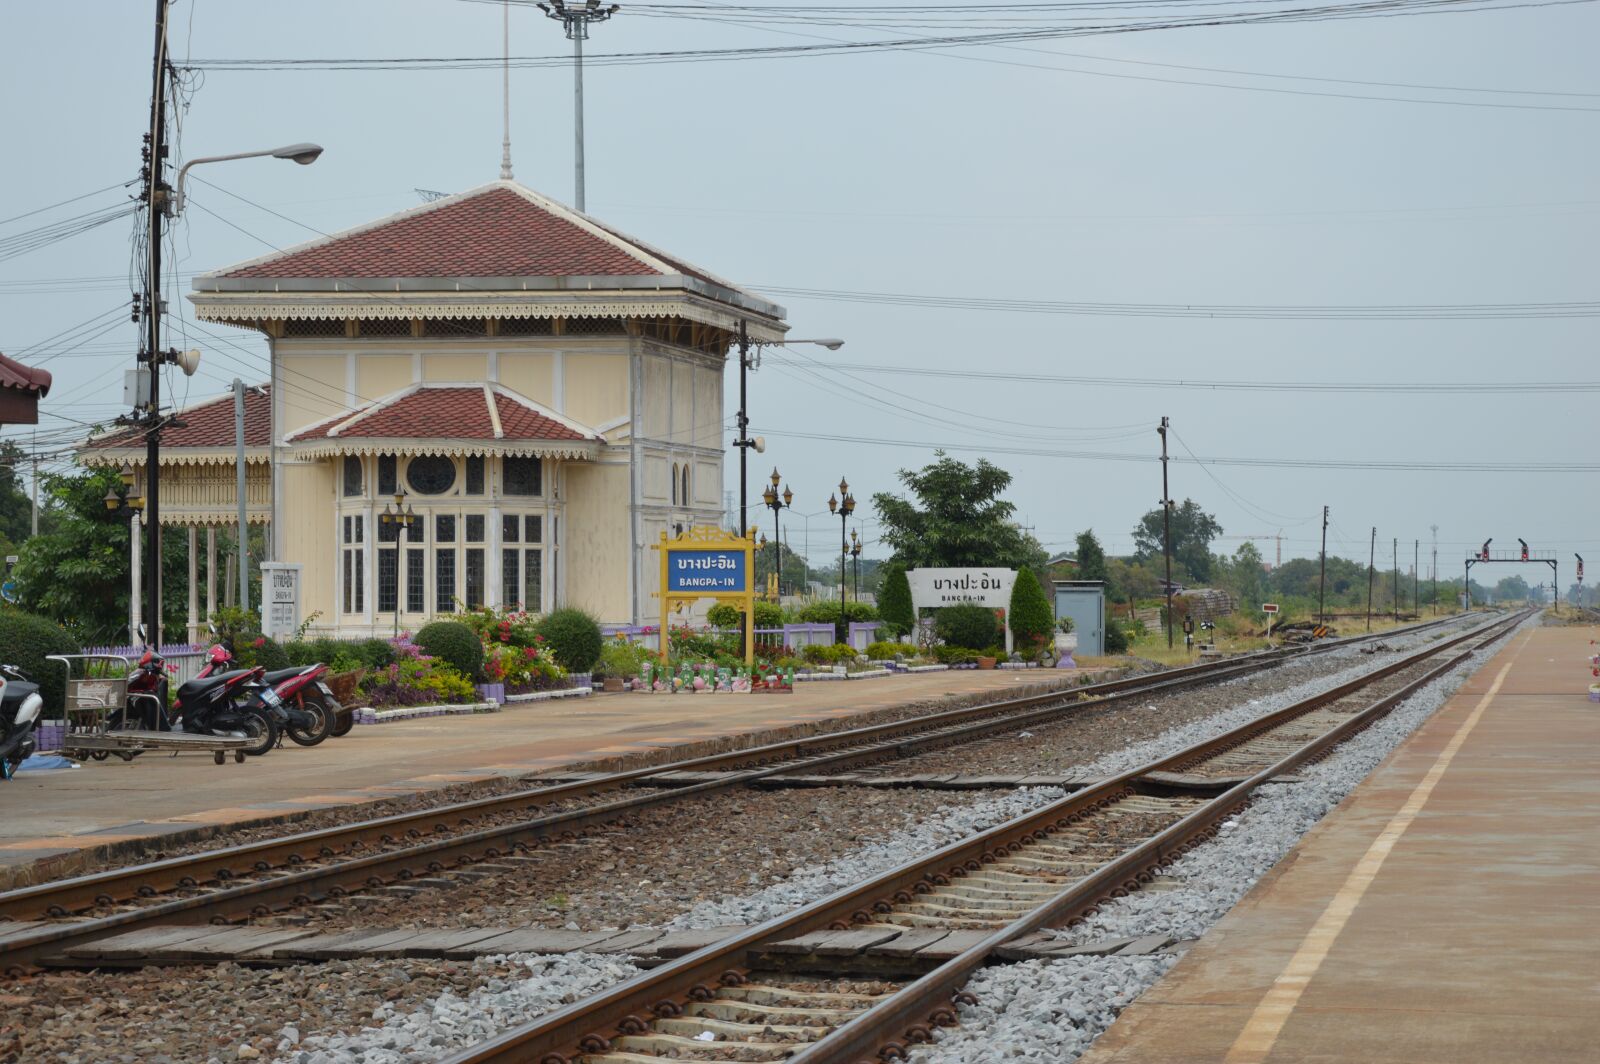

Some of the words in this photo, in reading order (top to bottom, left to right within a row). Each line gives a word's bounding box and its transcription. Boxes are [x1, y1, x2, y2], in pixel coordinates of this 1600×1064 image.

[678, 555, 736, 569] บางปะอิน
[679, 578, 735, 586] BANGPA-IN
[934, 572, 1001, 590] บางปะอิน
